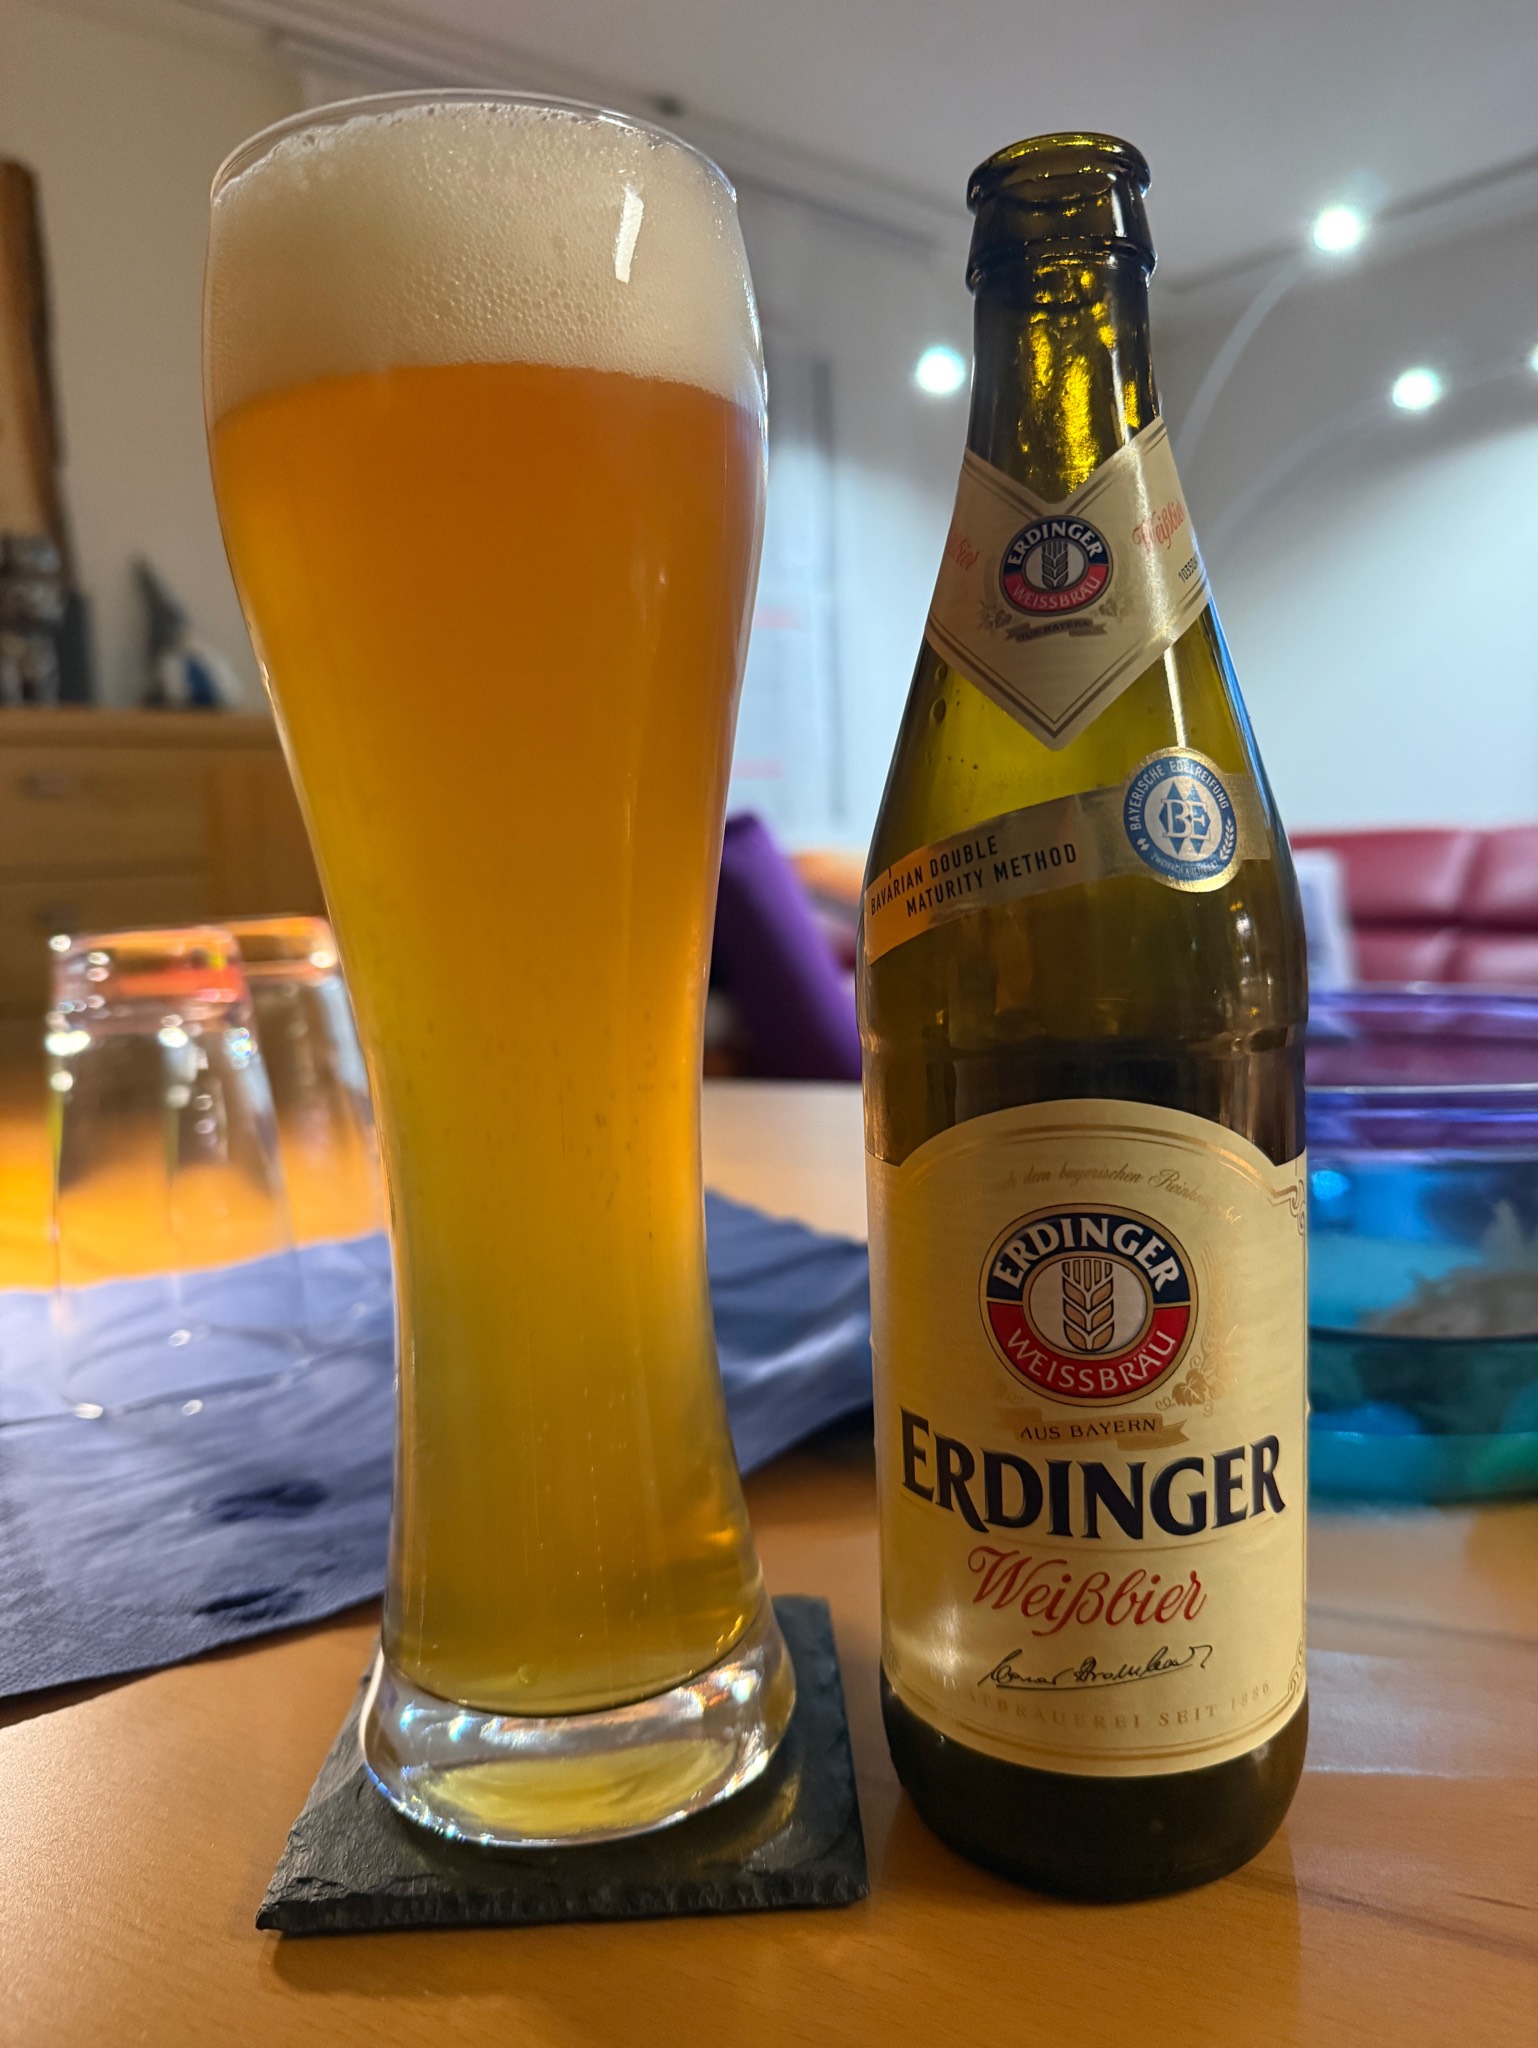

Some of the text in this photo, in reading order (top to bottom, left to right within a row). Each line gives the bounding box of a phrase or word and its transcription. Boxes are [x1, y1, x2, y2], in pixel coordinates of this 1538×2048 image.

[1007, 522, 1104, 566] ERDINGER
[1128, 761, 1229, 831] BAYERISCHE EDELREIFUNG
[1161, 799, 1211, 841] BE
[870, 834, 999, 916] BAVARIAN DOUBLE
[906, 842, 1077, 918] MATURITY METHOD
[1023, 1164, 1052, 1185] dem
[1059, 1161, 1143, 1187] bayerischen
[992, 1217, 1181, 1293] ERDINGER
[1007, 1328, 1177, 1394] WEISSBRÄU
[1020, 1419, 1157, 1441] AUS BAYERN
[900, 1408, 1287, 1540] ERDINGER
[967, 1545, 1208, 1637] Weißbier
[1159, 1704, 1218, 1727] SEIT
[1230, 1679, 1271, 1712] 1886
